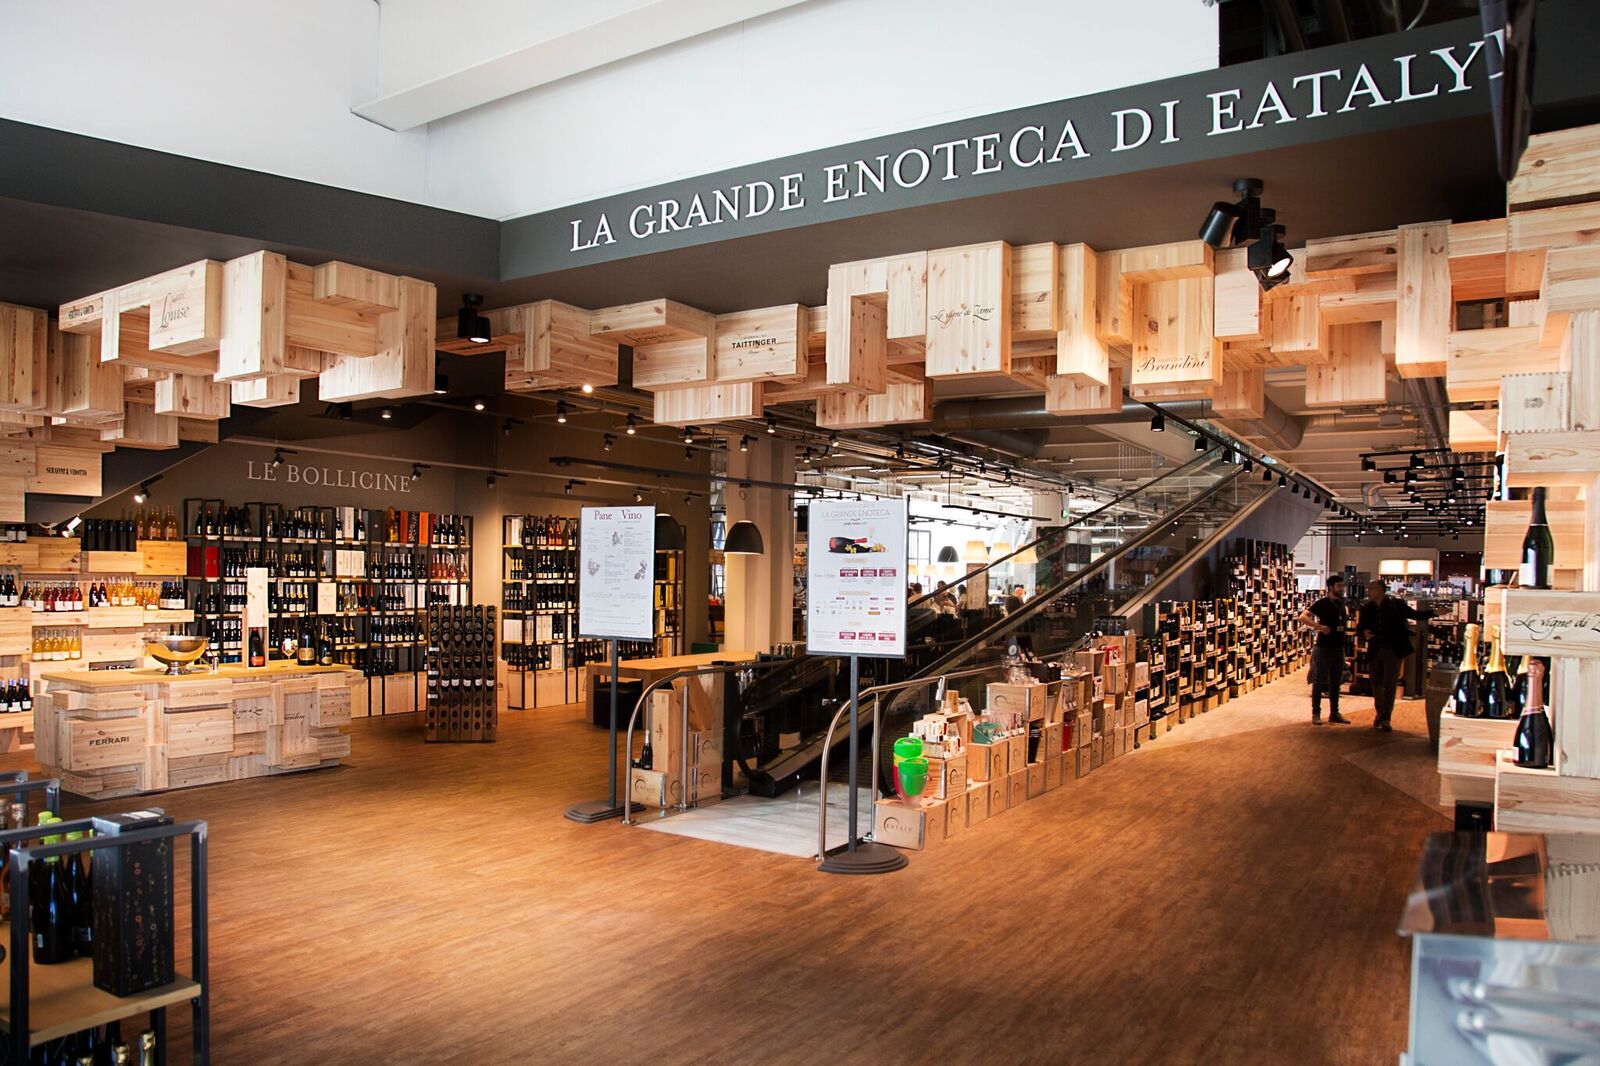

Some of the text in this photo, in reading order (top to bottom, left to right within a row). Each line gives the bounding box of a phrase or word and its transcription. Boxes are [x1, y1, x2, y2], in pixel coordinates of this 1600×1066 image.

[570, 40, 1486, 251] LA GRANDE ENOTECA DI EATALY
[731, 337, 778, 349] TAITTINGER
[1136, 353, 1210, 373] Brandini
[247, 460, 411, 493] LE BOLLICINE
[594, 509, 643, 520] Pane Vino
[89, 736, 130, 746] FERRARI
